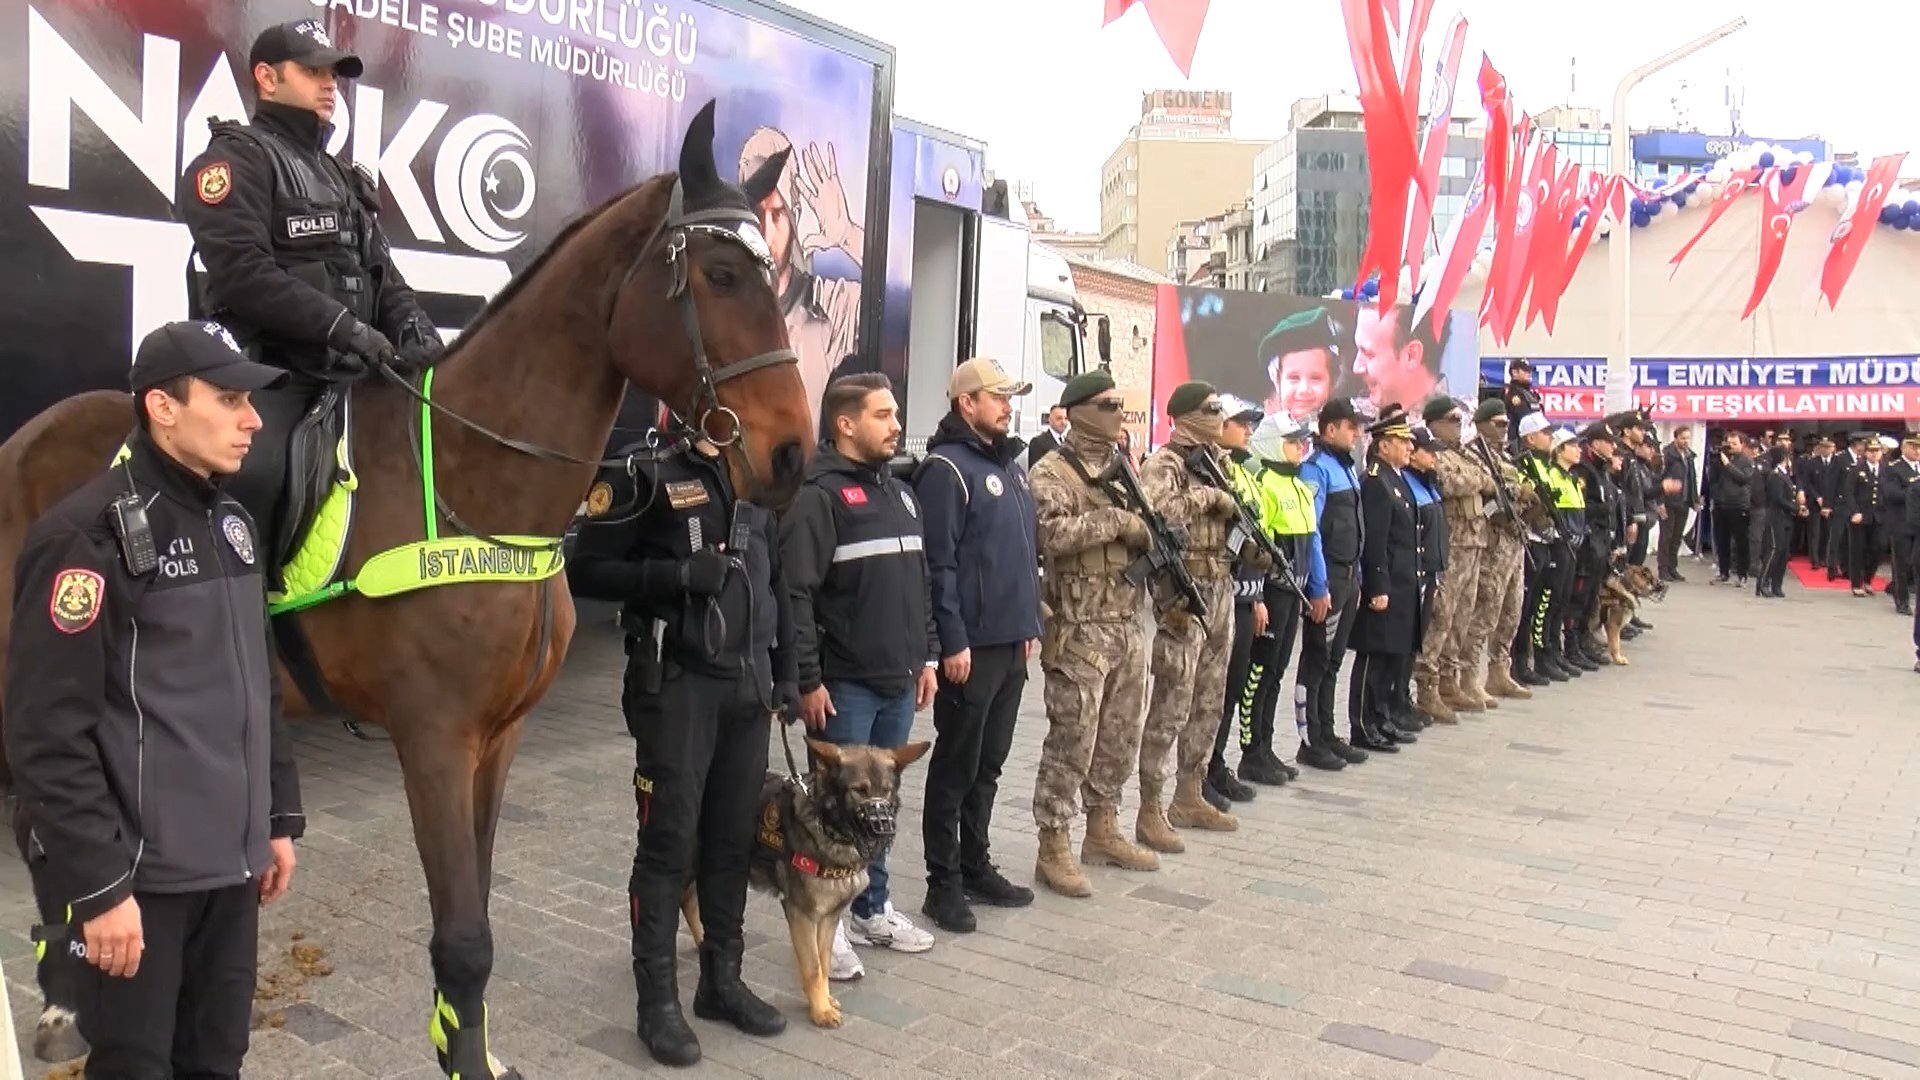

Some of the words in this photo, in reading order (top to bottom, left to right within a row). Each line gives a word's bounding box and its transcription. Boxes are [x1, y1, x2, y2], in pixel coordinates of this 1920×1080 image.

[446, 12, 523, 59] ŞUBE
[530, 34, 687, 103] MÜDÜRLÜĞÜ
[1668, 358, 1818, 386] EMNİYET
[1686, 388, 1905, 418] TEŞKİLATININ
